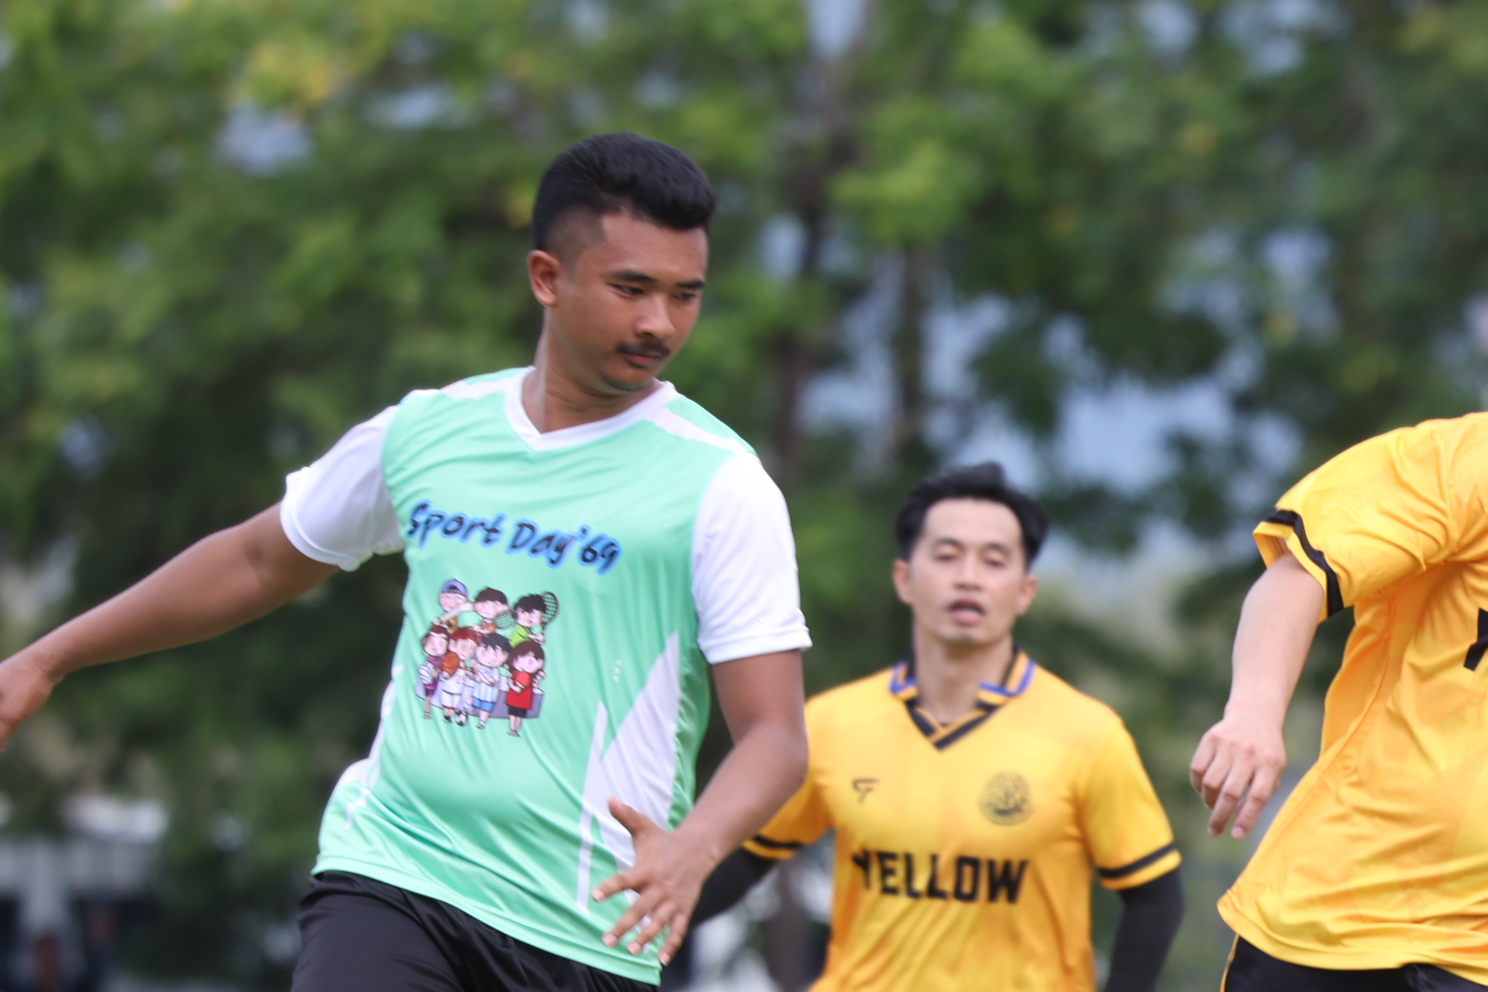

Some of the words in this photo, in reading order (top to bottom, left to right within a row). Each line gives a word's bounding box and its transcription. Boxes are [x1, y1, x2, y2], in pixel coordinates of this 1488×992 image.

[408, 499, 506, 548] Sport
[507, 518, 623, 575] Day'69
[852, 845, 1029, 905] YELLOW
